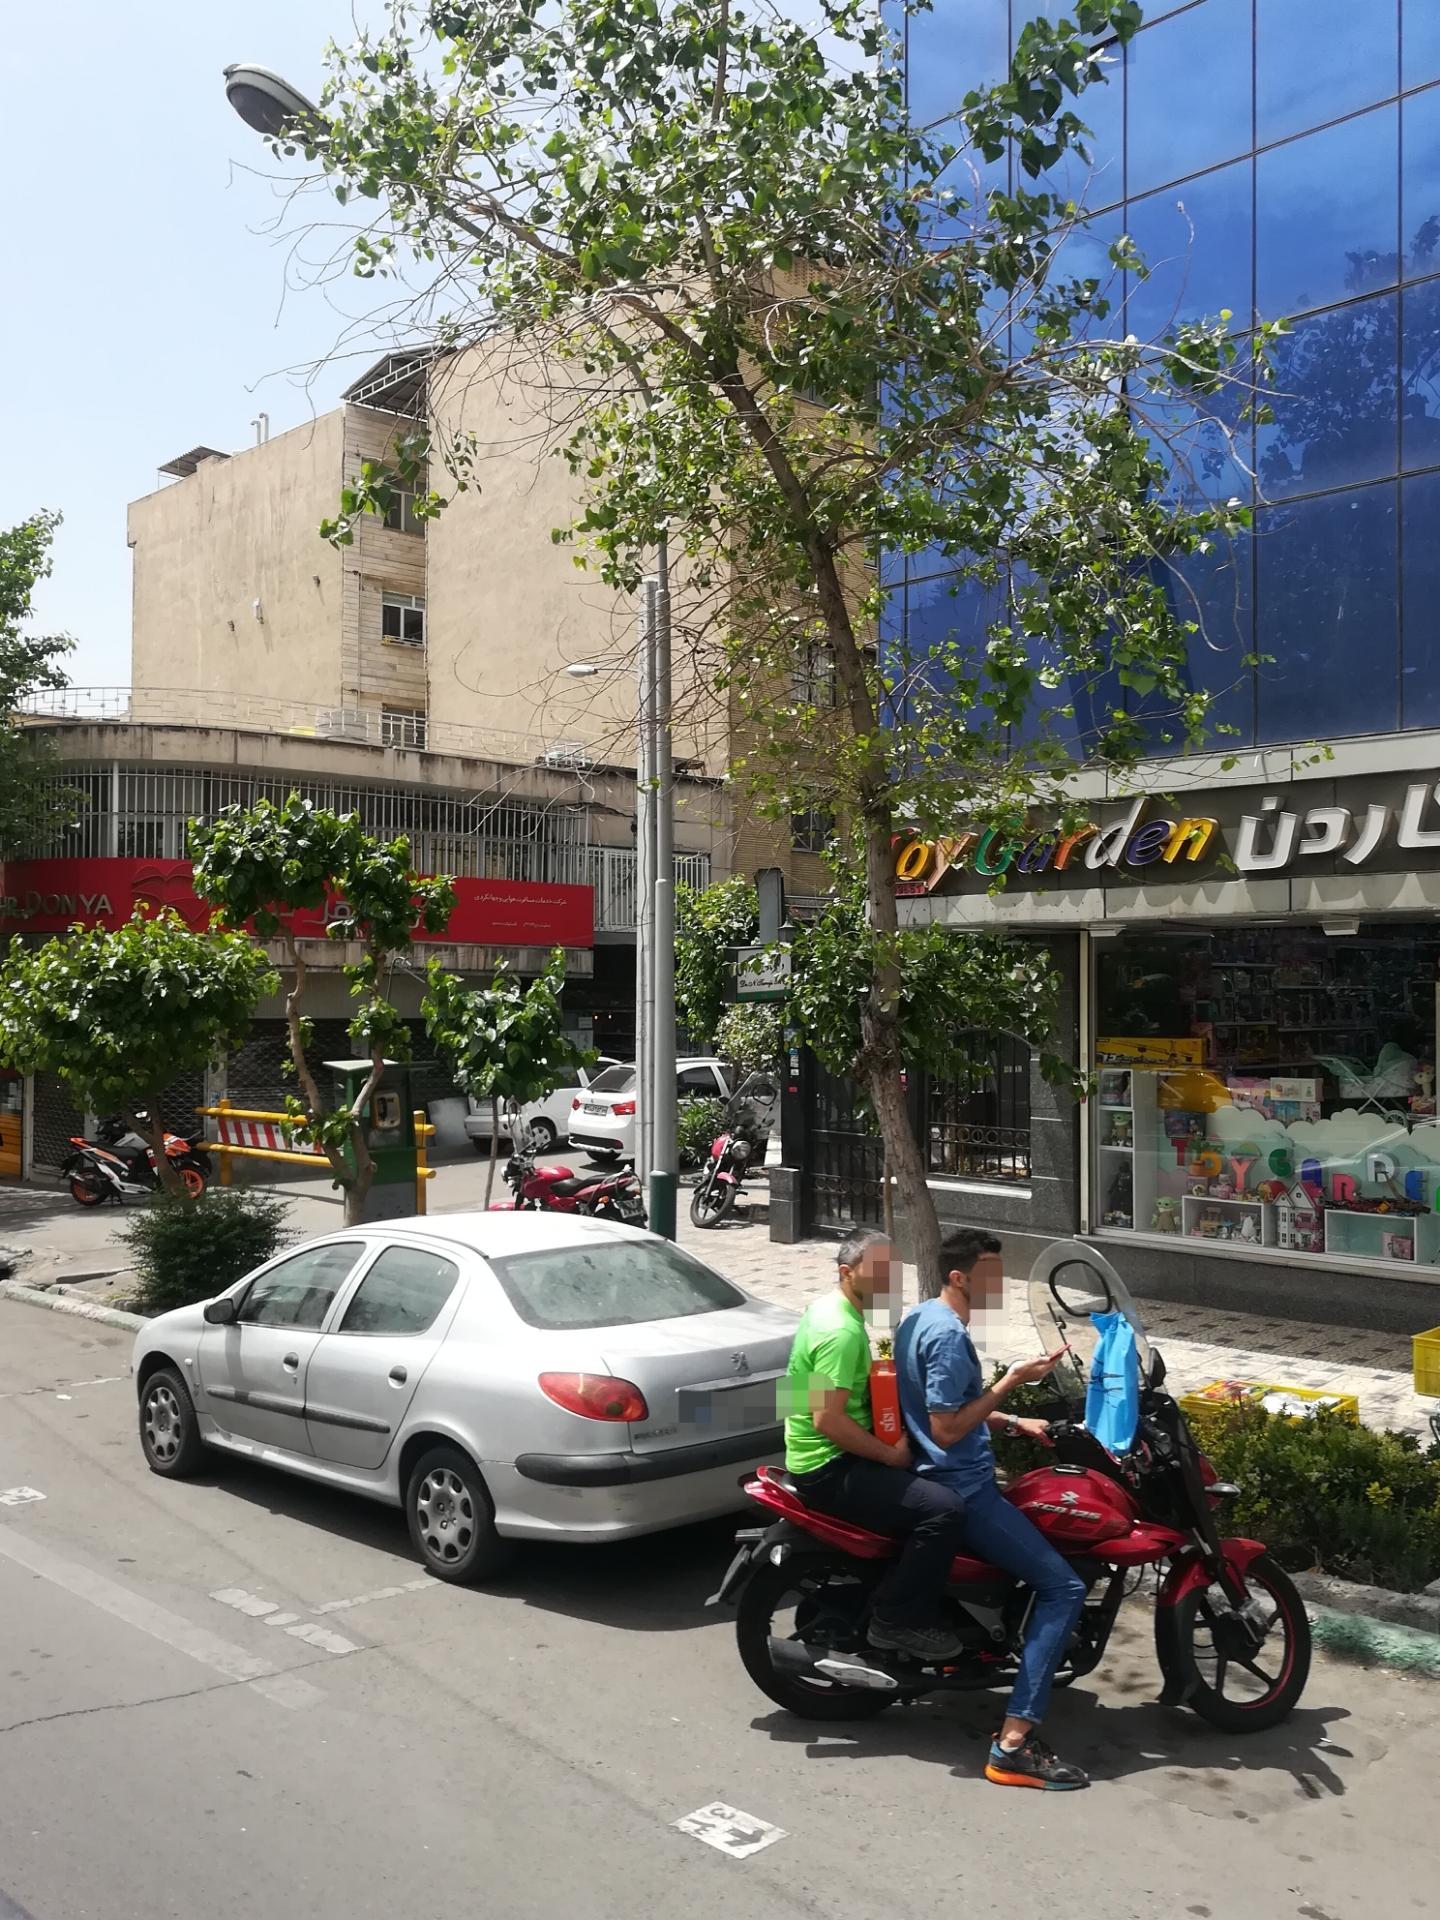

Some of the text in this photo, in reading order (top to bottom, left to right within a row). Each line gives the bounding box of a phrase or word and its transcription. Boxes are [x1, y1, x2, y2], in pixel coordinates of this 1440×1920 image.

[891, 799, 1219, 892] oy Garden
[1234, 783, 1440, 871] اردن
[25, 890, 114, 915] DONYA
[1268, 1148, 1440, 1215] GARDE
